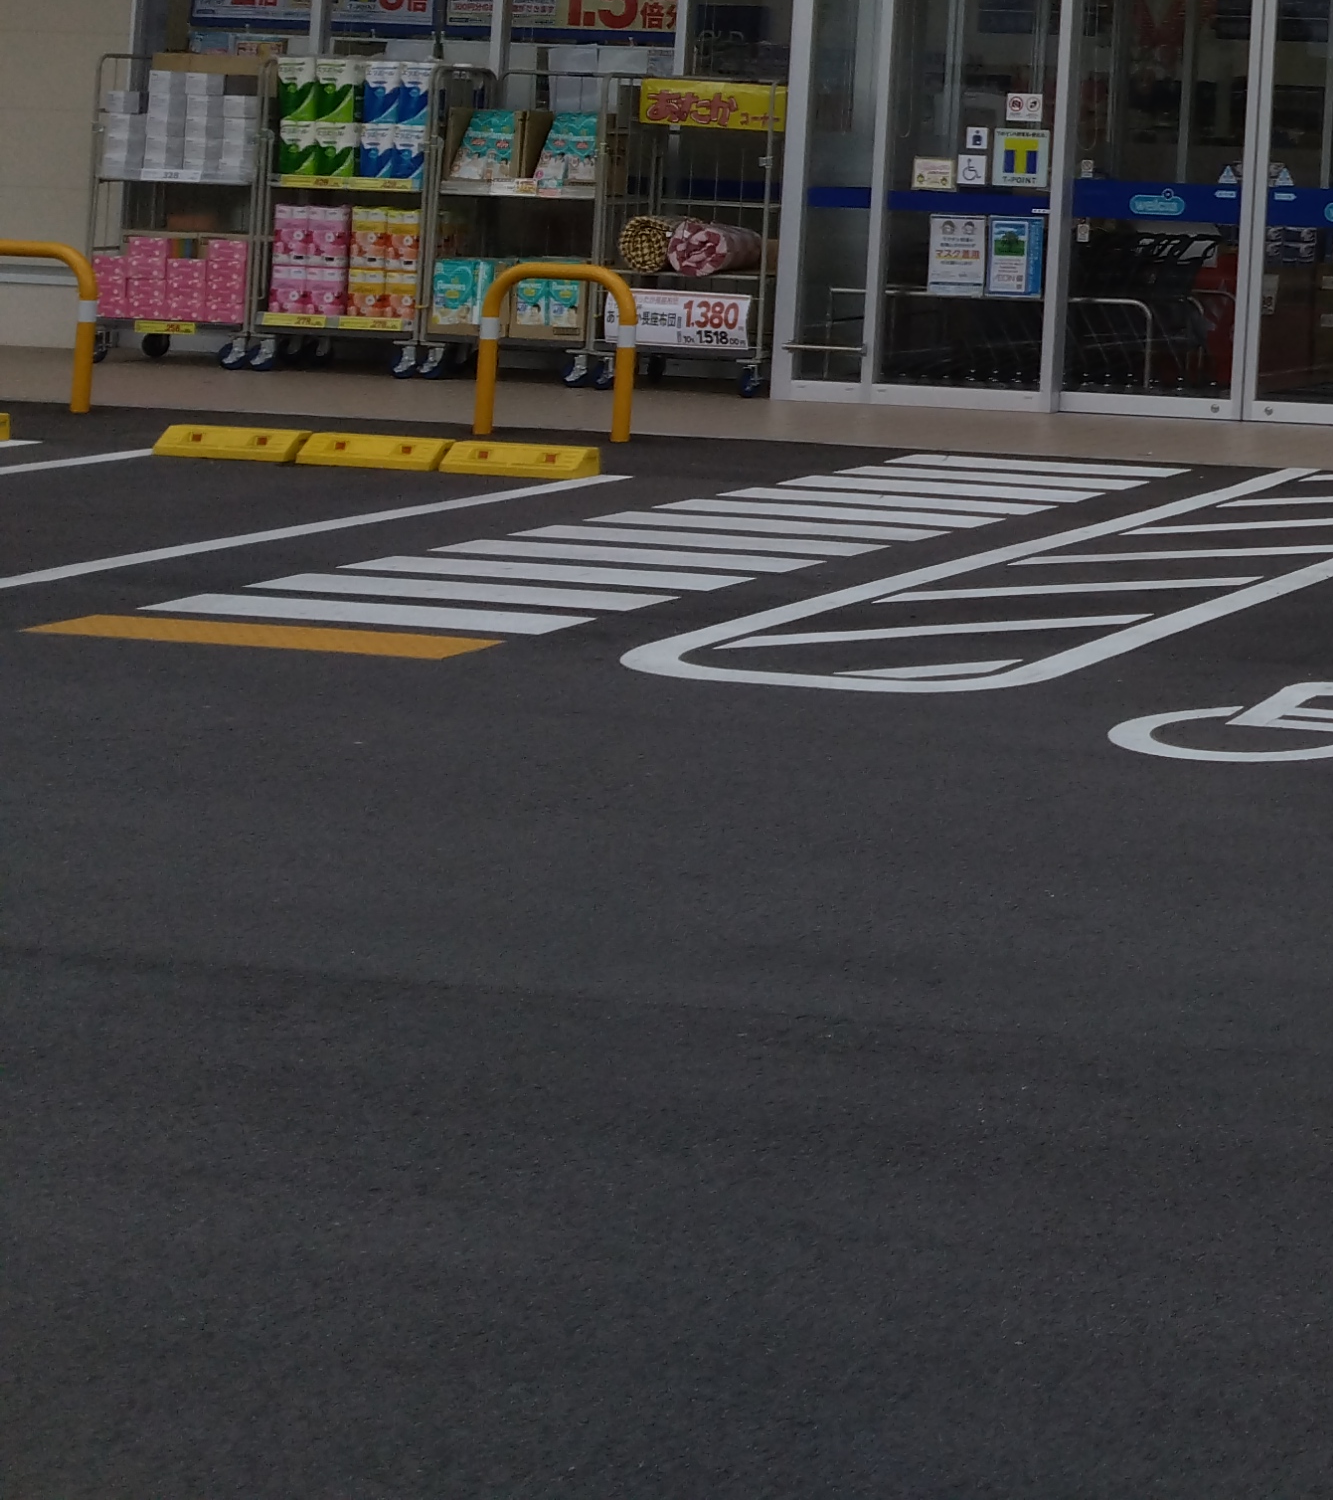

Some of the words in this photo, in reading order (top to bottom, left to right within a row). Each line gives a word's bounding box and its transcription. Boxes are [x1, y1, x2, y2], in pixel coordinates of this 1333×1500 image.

[1001, 175, 1038, 185] T-POINT
[1134, 199, 1180, 213] welcia
[606, 309, 677, 328] あ長座布団
